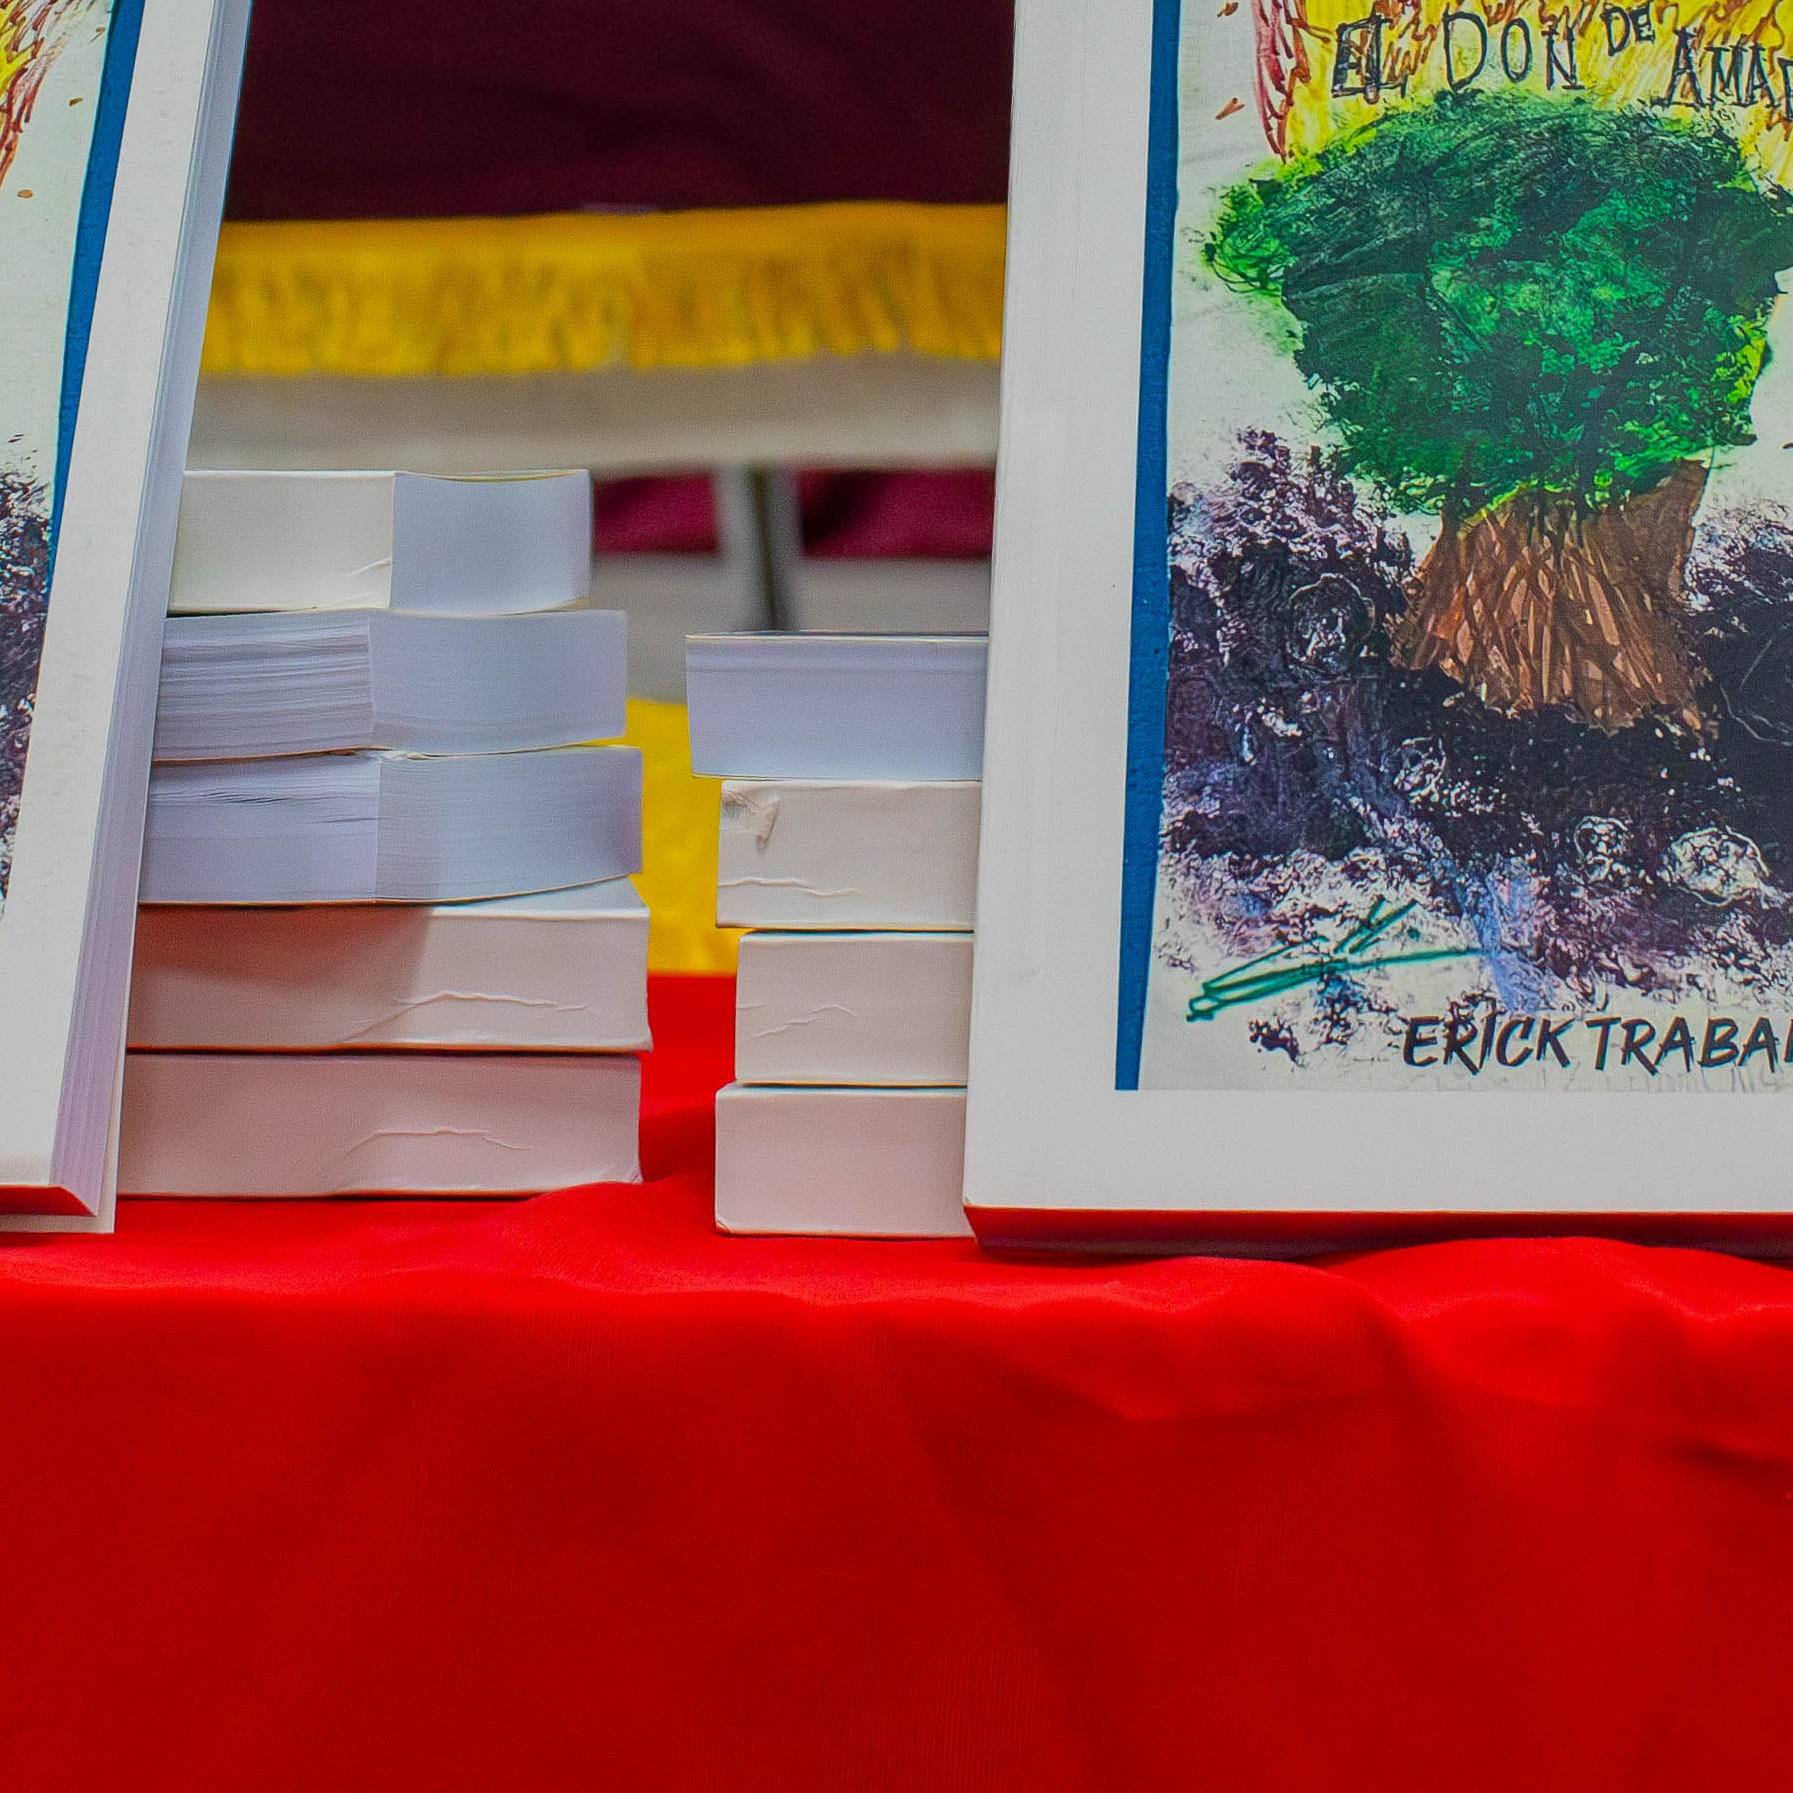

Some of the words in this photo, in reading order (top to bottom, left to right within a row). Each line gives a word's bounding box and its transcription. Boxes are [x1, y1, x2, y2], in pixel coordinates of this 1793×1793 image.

[1443, 7, 1584, 95] DON
[1602, 6, 1656, 57] DE
[1402, 1012, 1573, 1076] ERICK
